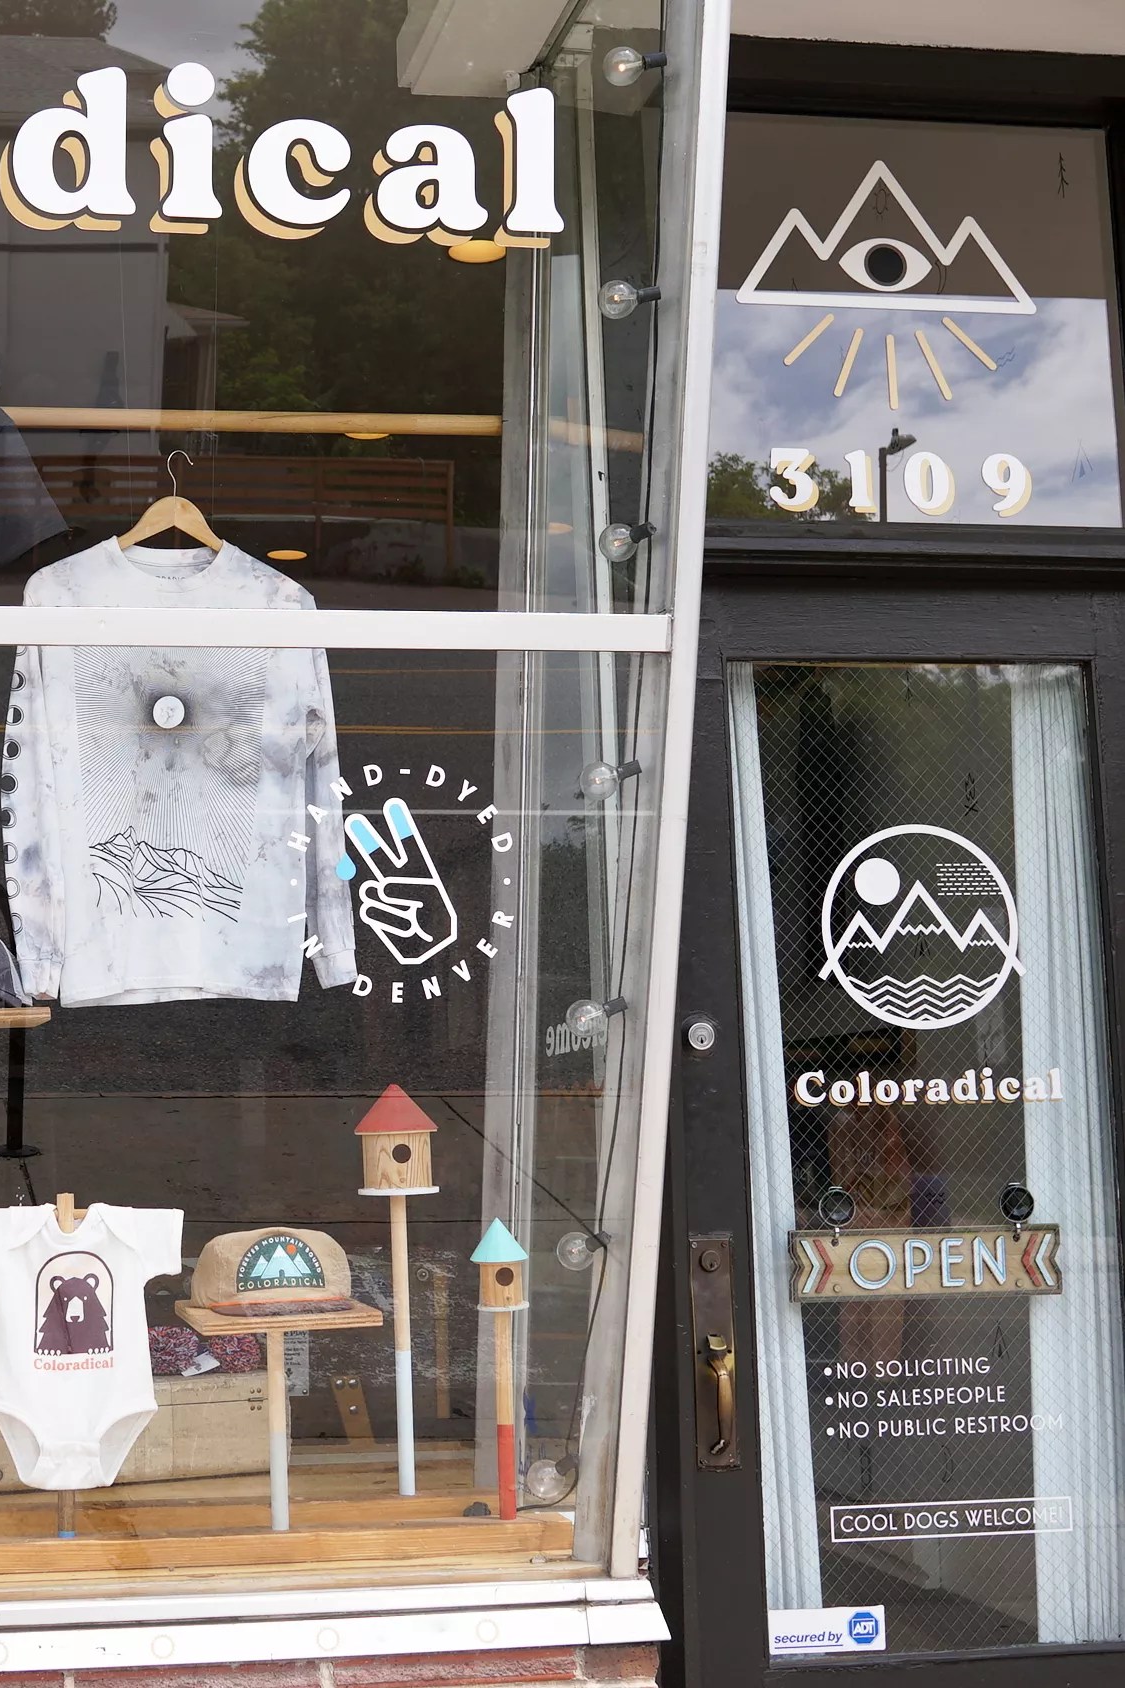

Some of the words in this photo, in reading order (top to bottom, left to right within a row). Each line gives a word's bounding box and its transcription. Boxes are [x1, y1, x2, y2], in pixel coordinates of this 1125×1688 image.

[769, 447, 1032, 518] 3109
[351, 909, 515, 1004] DENVER
[794, 1066, 1065, 1107] Coloradical
[261, 1236, 304, 1248] MOUNTAIN
[304, 1246, 322, 1273] BOUND
[848, 1235, 1008, 1291] OPEN
[238, 1277, 324, 1291] COLORADICAL
[33, 1356, 114, 1371] Coloradical
[836, 1361, 867, 1380] NO
[875, 1357, 991, 1379] SOLICITING
[837, 1390, 868, 1409] NO
[876, 1385, 1006, 1408] SALESPEOPLE
[839, 1421, 870, 1439] NO
[878, 1418, 947, 1438] PUBLIC
[955, 1413, 1064, 1435] RESTROOM
[840, 1513, 898, 1533] COOL
[904, 1510, 959, 1531] DOGS
[965, 1506, 1064, 1528] WELCOME!
[774, 1631, 826, 1644] secured
[827, 1631, 843, 1643] by
[852, 1621, 875, 1635] ADT
